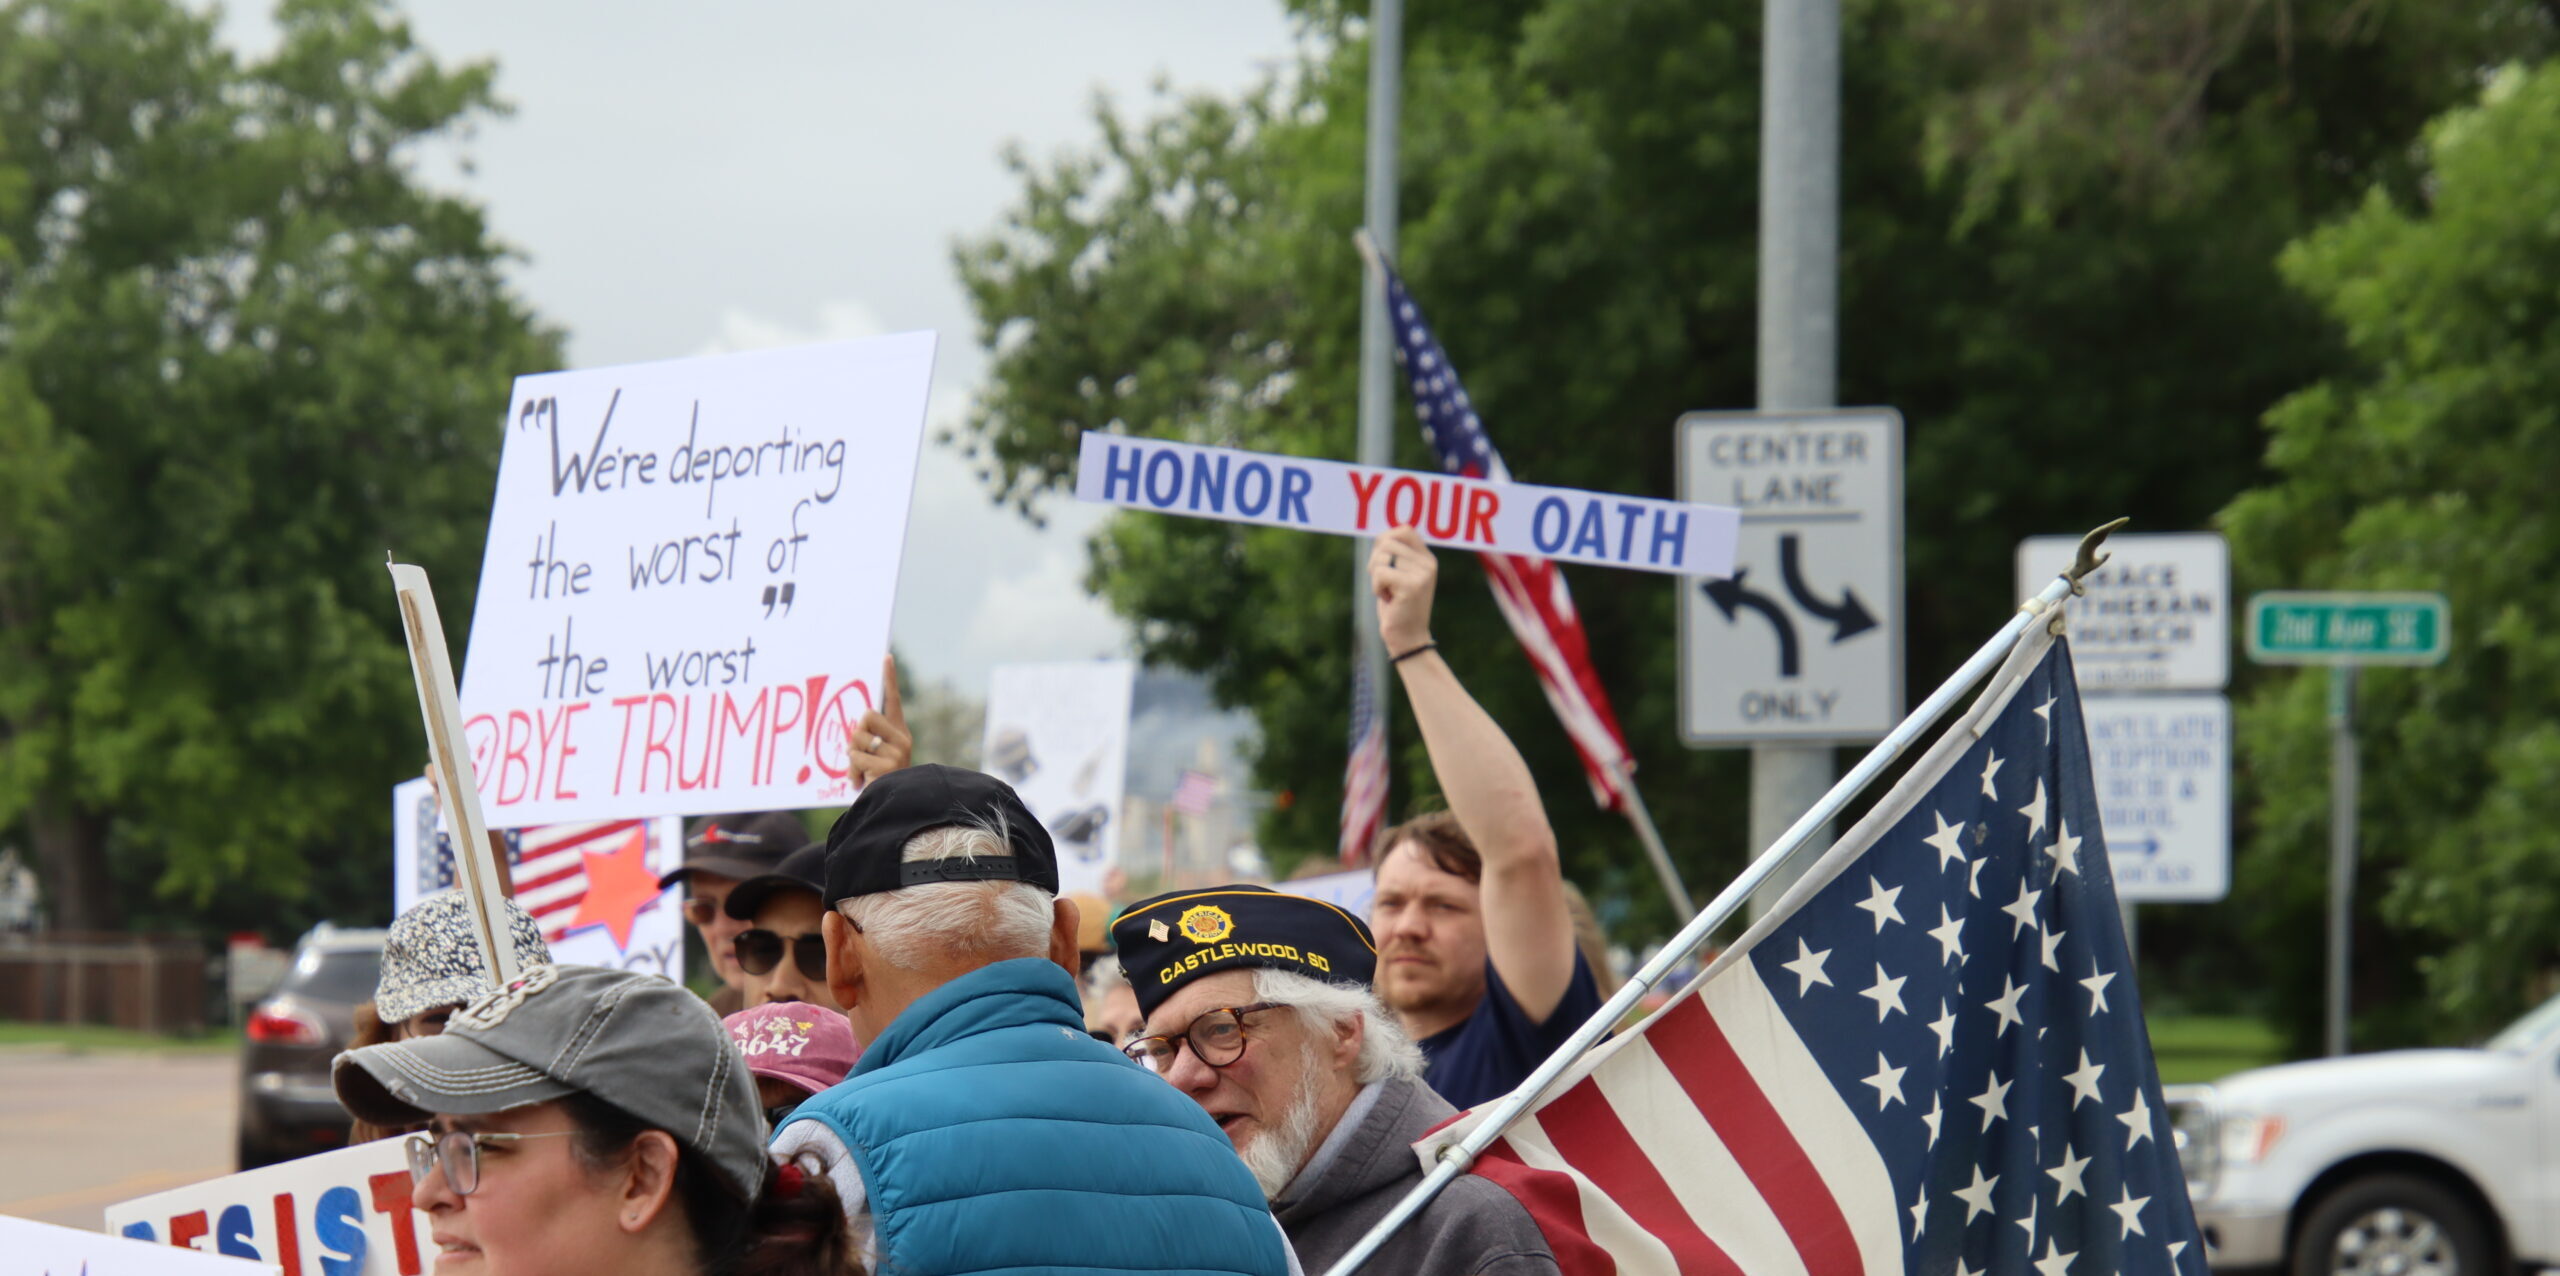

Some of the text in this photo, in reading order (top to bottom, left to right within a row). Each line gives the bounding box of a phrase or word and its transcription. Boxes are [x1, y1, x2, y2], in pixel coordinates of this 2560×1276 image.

[669, 399, 846, 519] deporting
[1708, 432, 1868, 465] CENTER
[1103, 445, 1688, 567] HONOR YOUR OATH
[1732, 475, 1843, 506] LANE
[528, 498, 811, 600] the worst of
[2084, 565, 2178, 588] RACE
[2066, 594, 2213, 617] THERAN
[2073, 622, 2194, 643] HURCH
[536, 616, 608, 699] the
[646, 637, 756, 691] worst
[1739, 691, 1840, 720] ONLY
[495, 699, 591, 806] BYE
[611, 674, 830, 796] TRUMP!
[1307, 951, 1331, 973] SD
[122, 1170, 421, 1276] SIST
